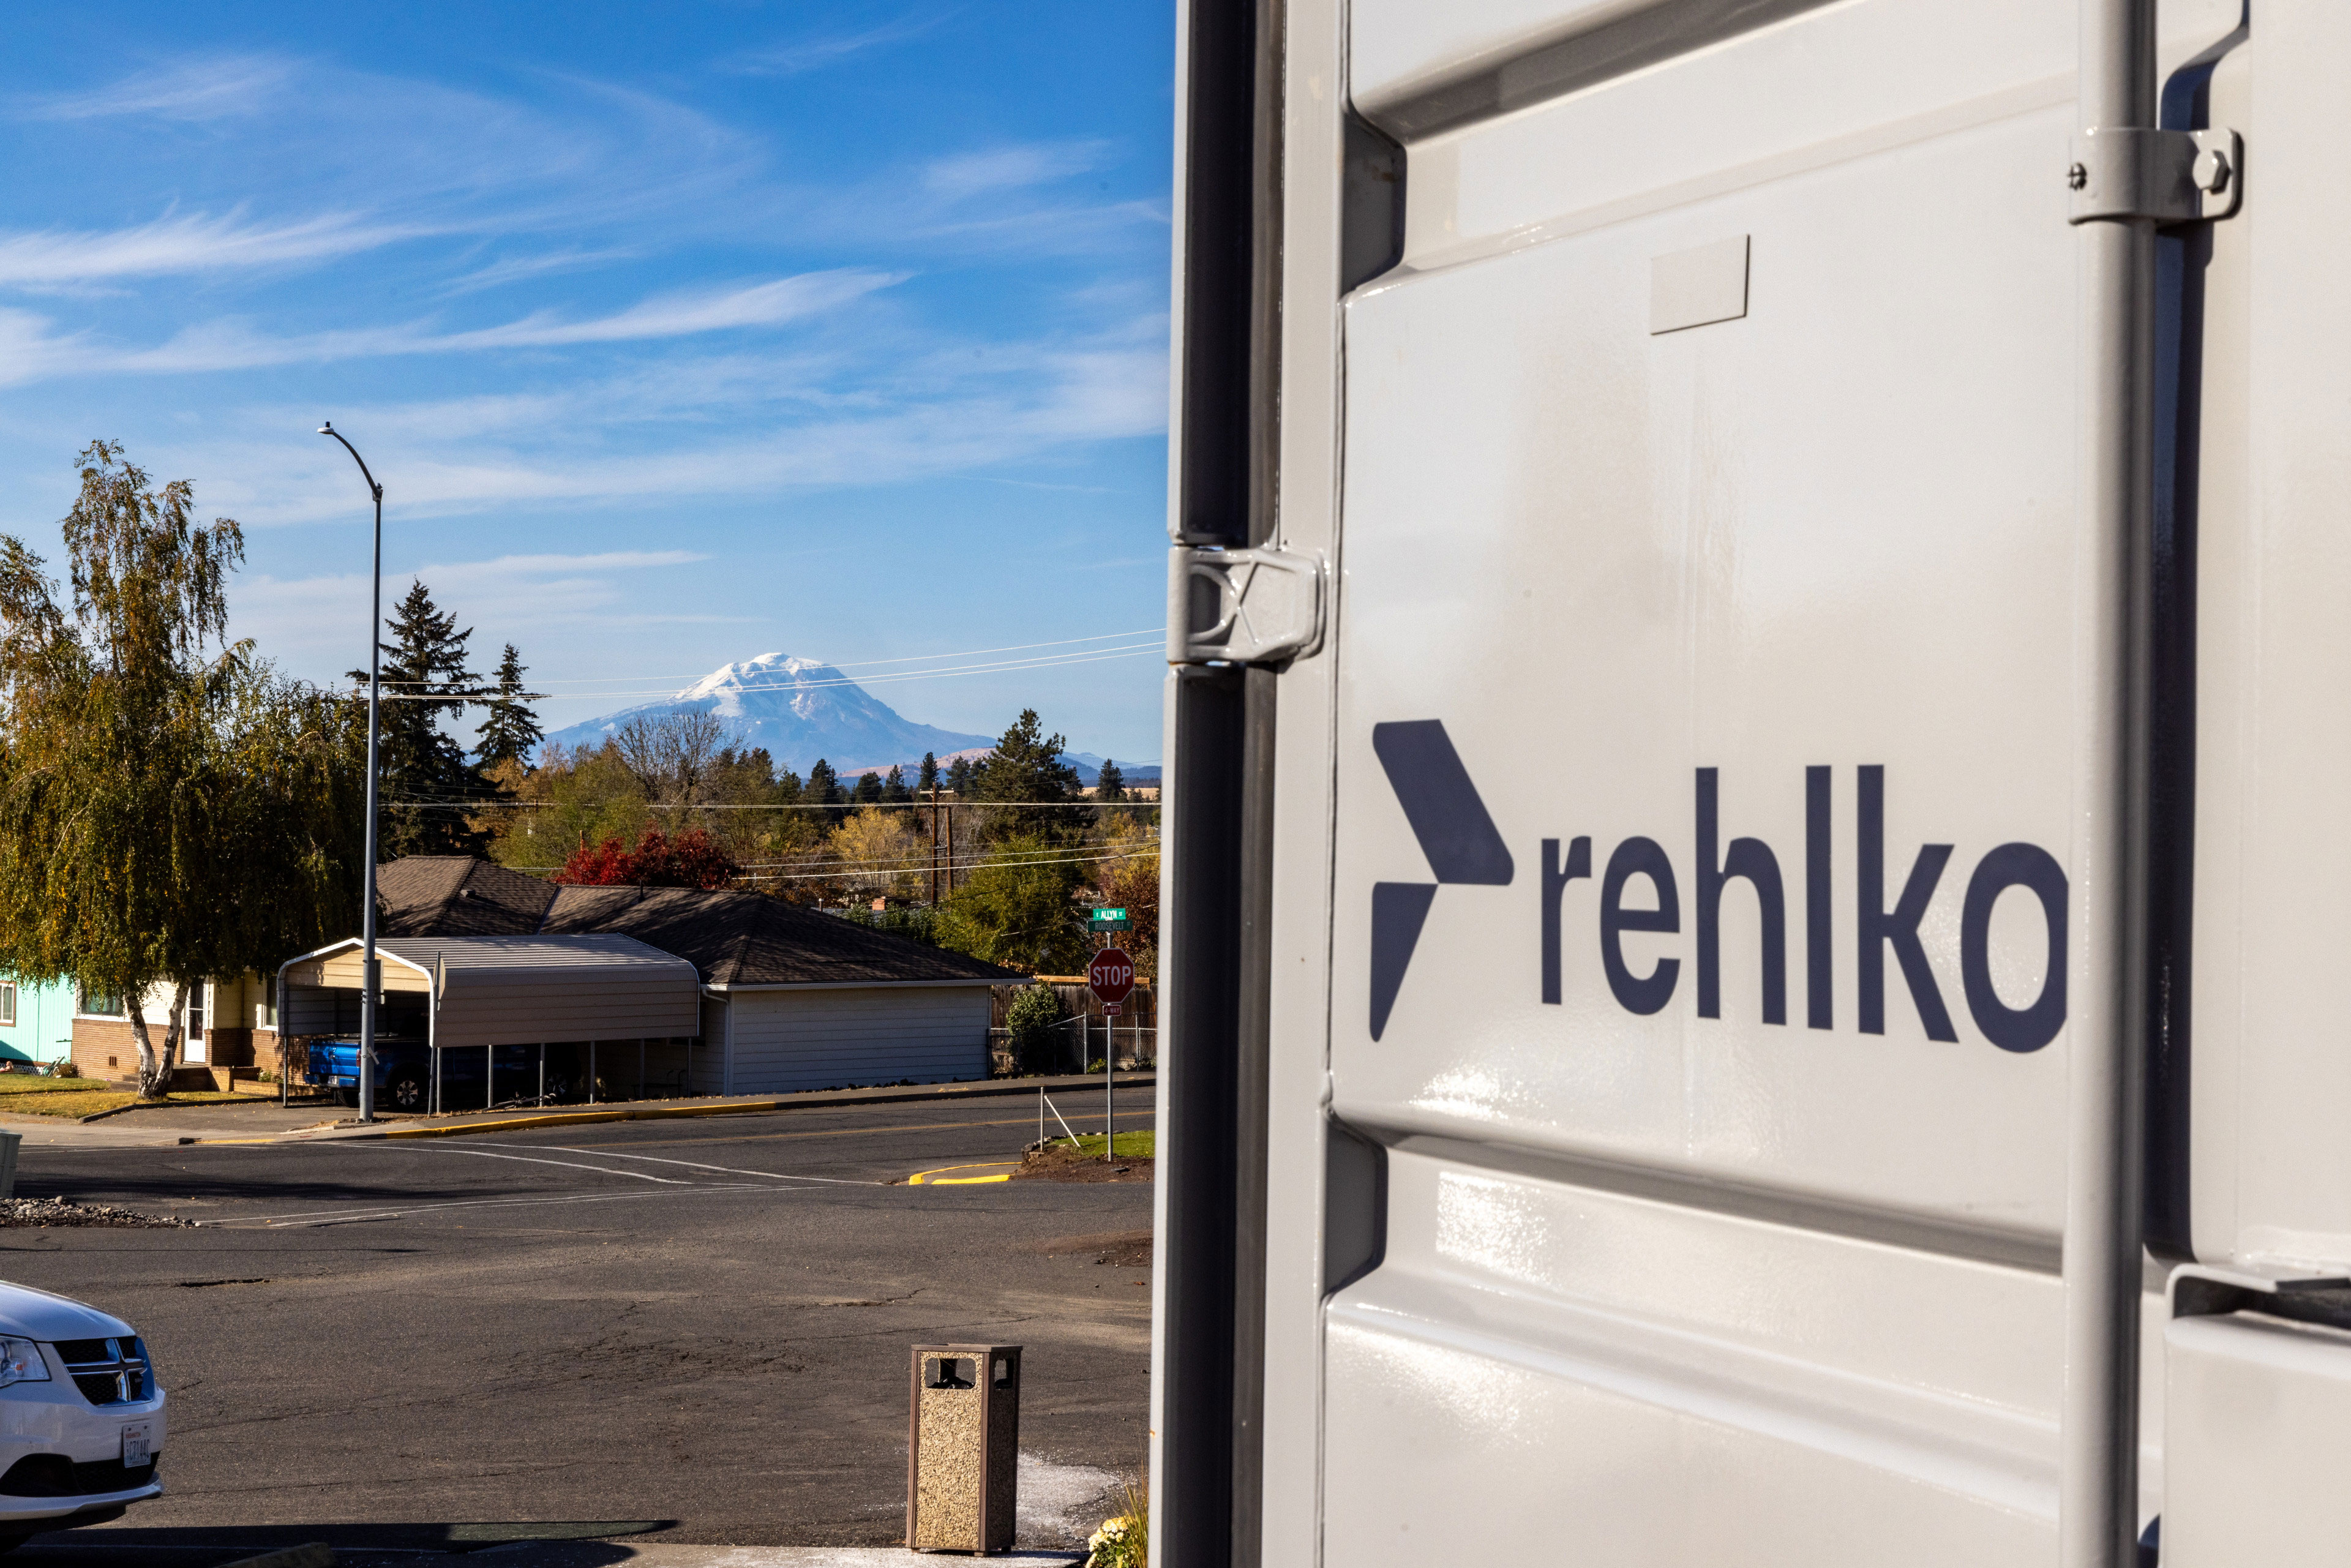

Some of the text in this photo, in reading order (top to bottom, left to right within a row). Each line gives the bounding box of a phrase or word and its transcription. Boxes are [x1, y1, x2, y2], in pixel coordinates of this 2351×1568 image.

[1101, 910, 1117, 919] ALLYN
[1541, 764, 2069, 1053] rehlko
[1095, 921, 1124, 931] ROOSEVELT
[1093, 966, 1131, 986] STOP
